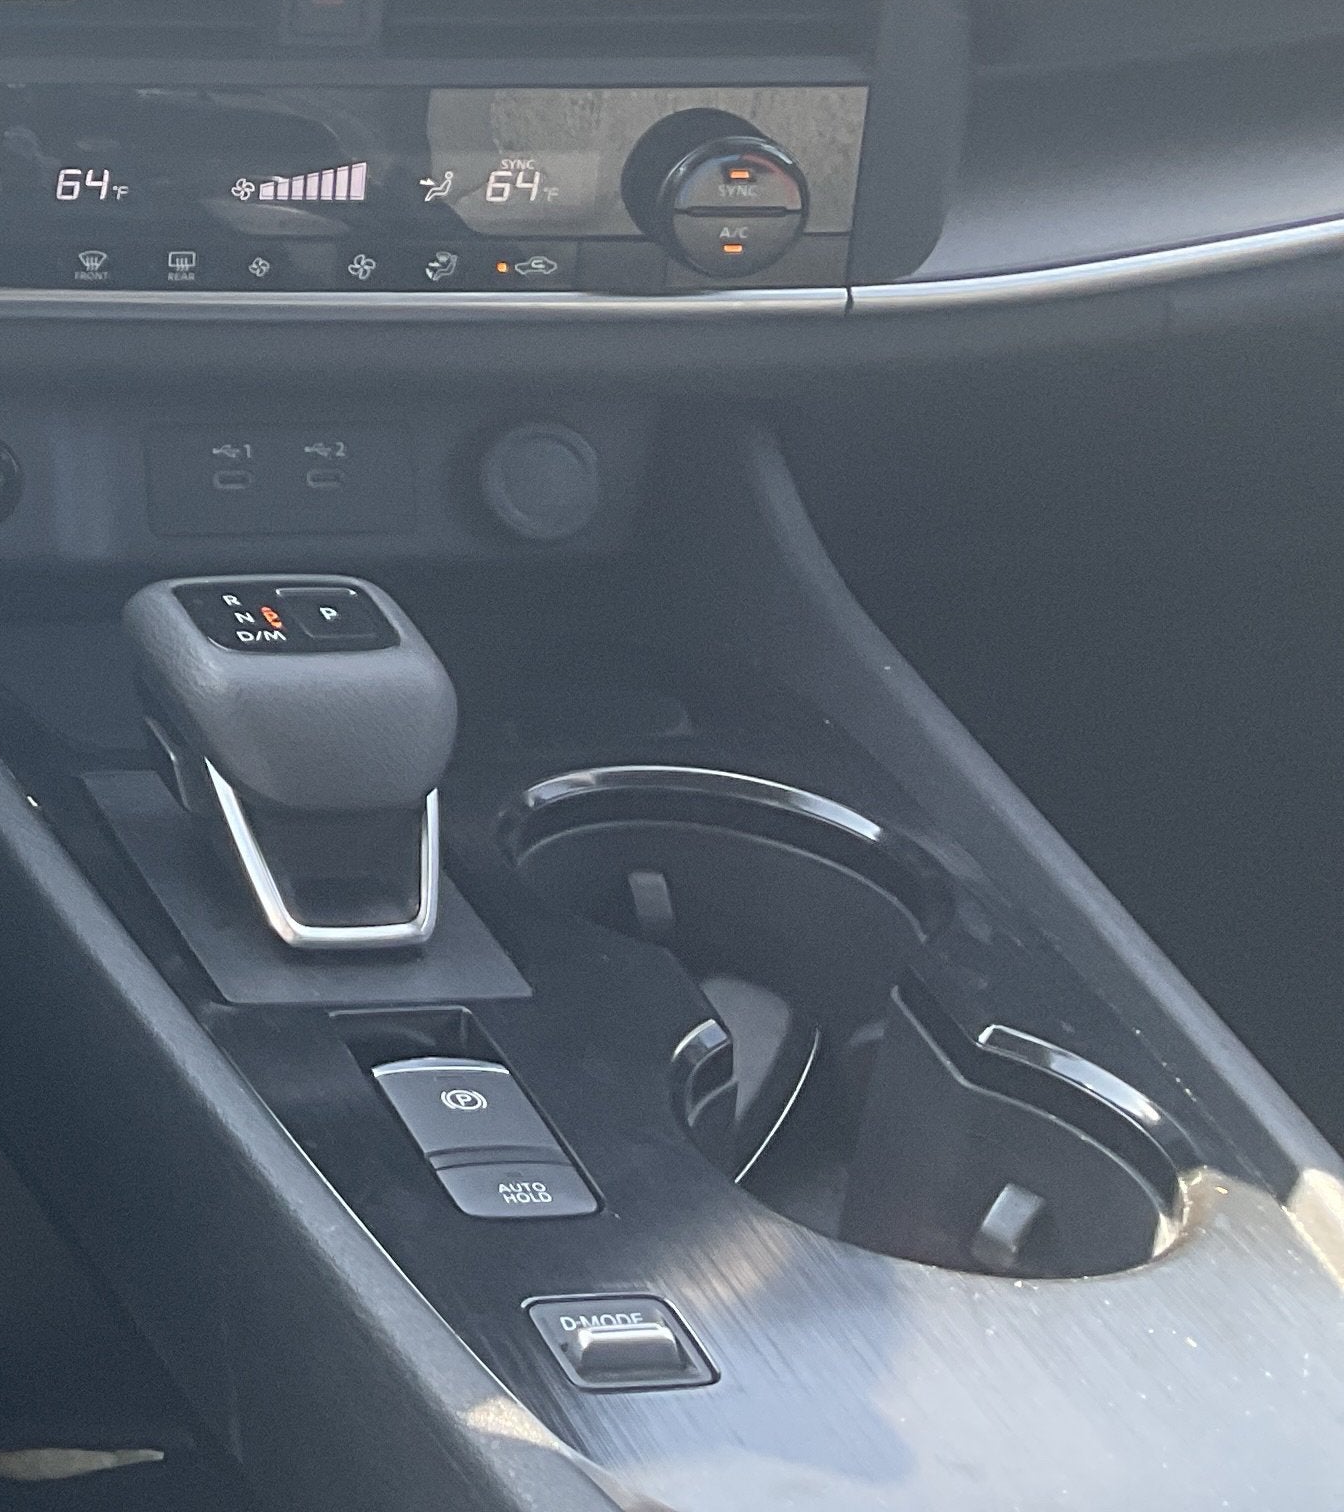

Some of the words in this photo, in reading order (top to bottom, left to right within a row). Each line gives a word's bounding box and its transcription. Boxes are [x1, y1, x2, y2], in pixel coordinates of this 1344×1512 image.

[501, 159, 536, 170] SYNC
[718, 184, 758, 197] SYNC
[720, 227, 748, 239] A/C
[74, 271, 108, 280] FRONT
[168, 272, 195, 280] REAR
[243, 444, 251, 458] 1
[335, 442, 346, 457] 2
[222, 594, 242, 606] R
[234, 612, 255, 623] N
[320, 607, 339, 620] P
[236, 630, 287, 642] D/M
[499, 1182, 546, 1193] AUTO
[503, 1192, 552, 1203] HOLD
